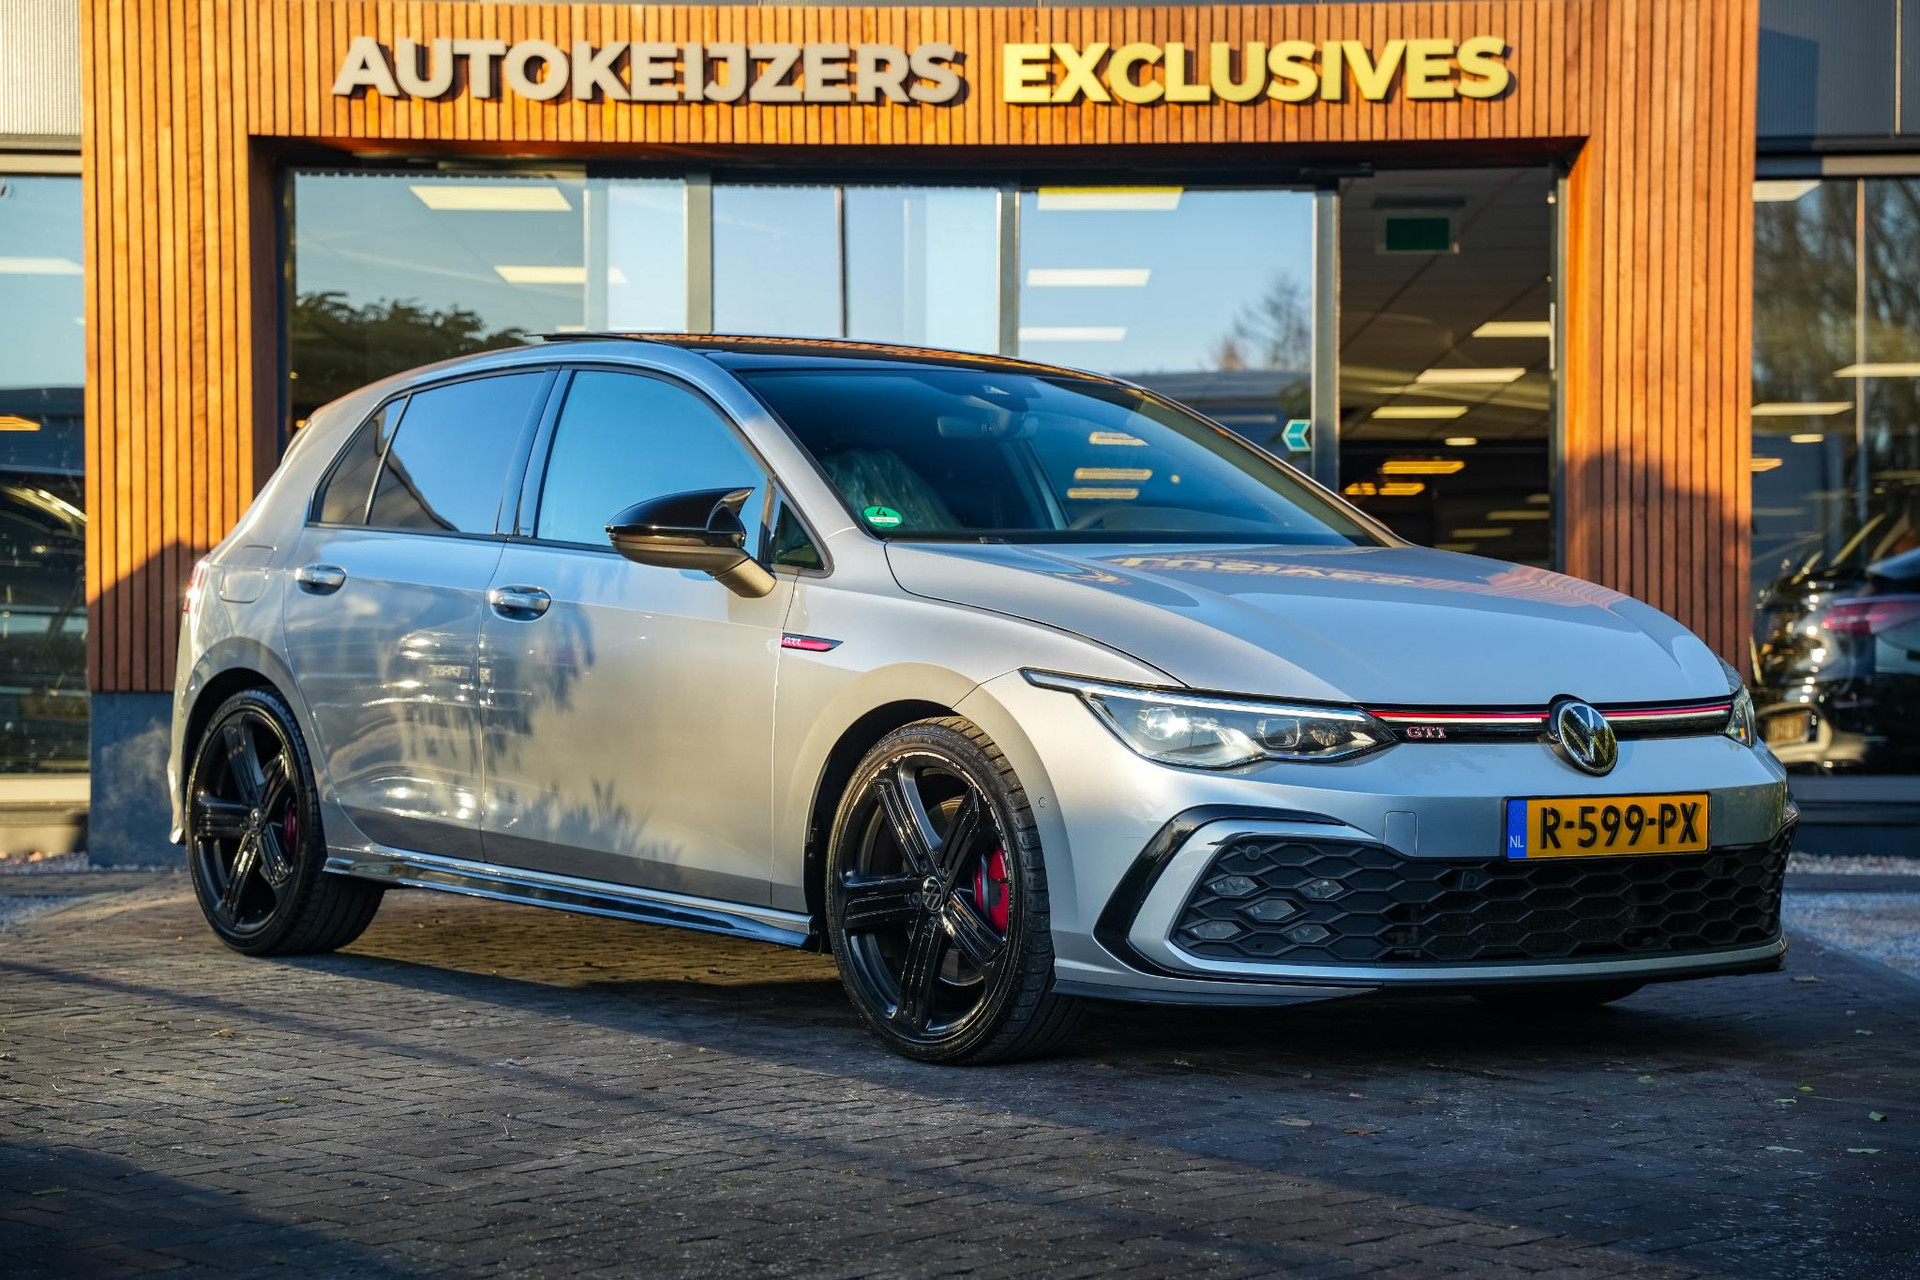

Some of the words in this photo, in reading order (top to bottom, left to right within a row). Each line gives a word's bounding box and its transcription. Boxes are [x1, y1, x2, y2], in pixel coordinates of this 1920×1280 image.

[333, 36, 963, 103] AUTOKEIJZERS
[1003, 36, 1509, 104] EXCLUSIVES
[876, 507, 887, 517] 4
[1406, 726, 1447, 739] GTI
[1540, 802, 1699, 849] R-599-PX
[1509, 835, 1524, 848] NL
